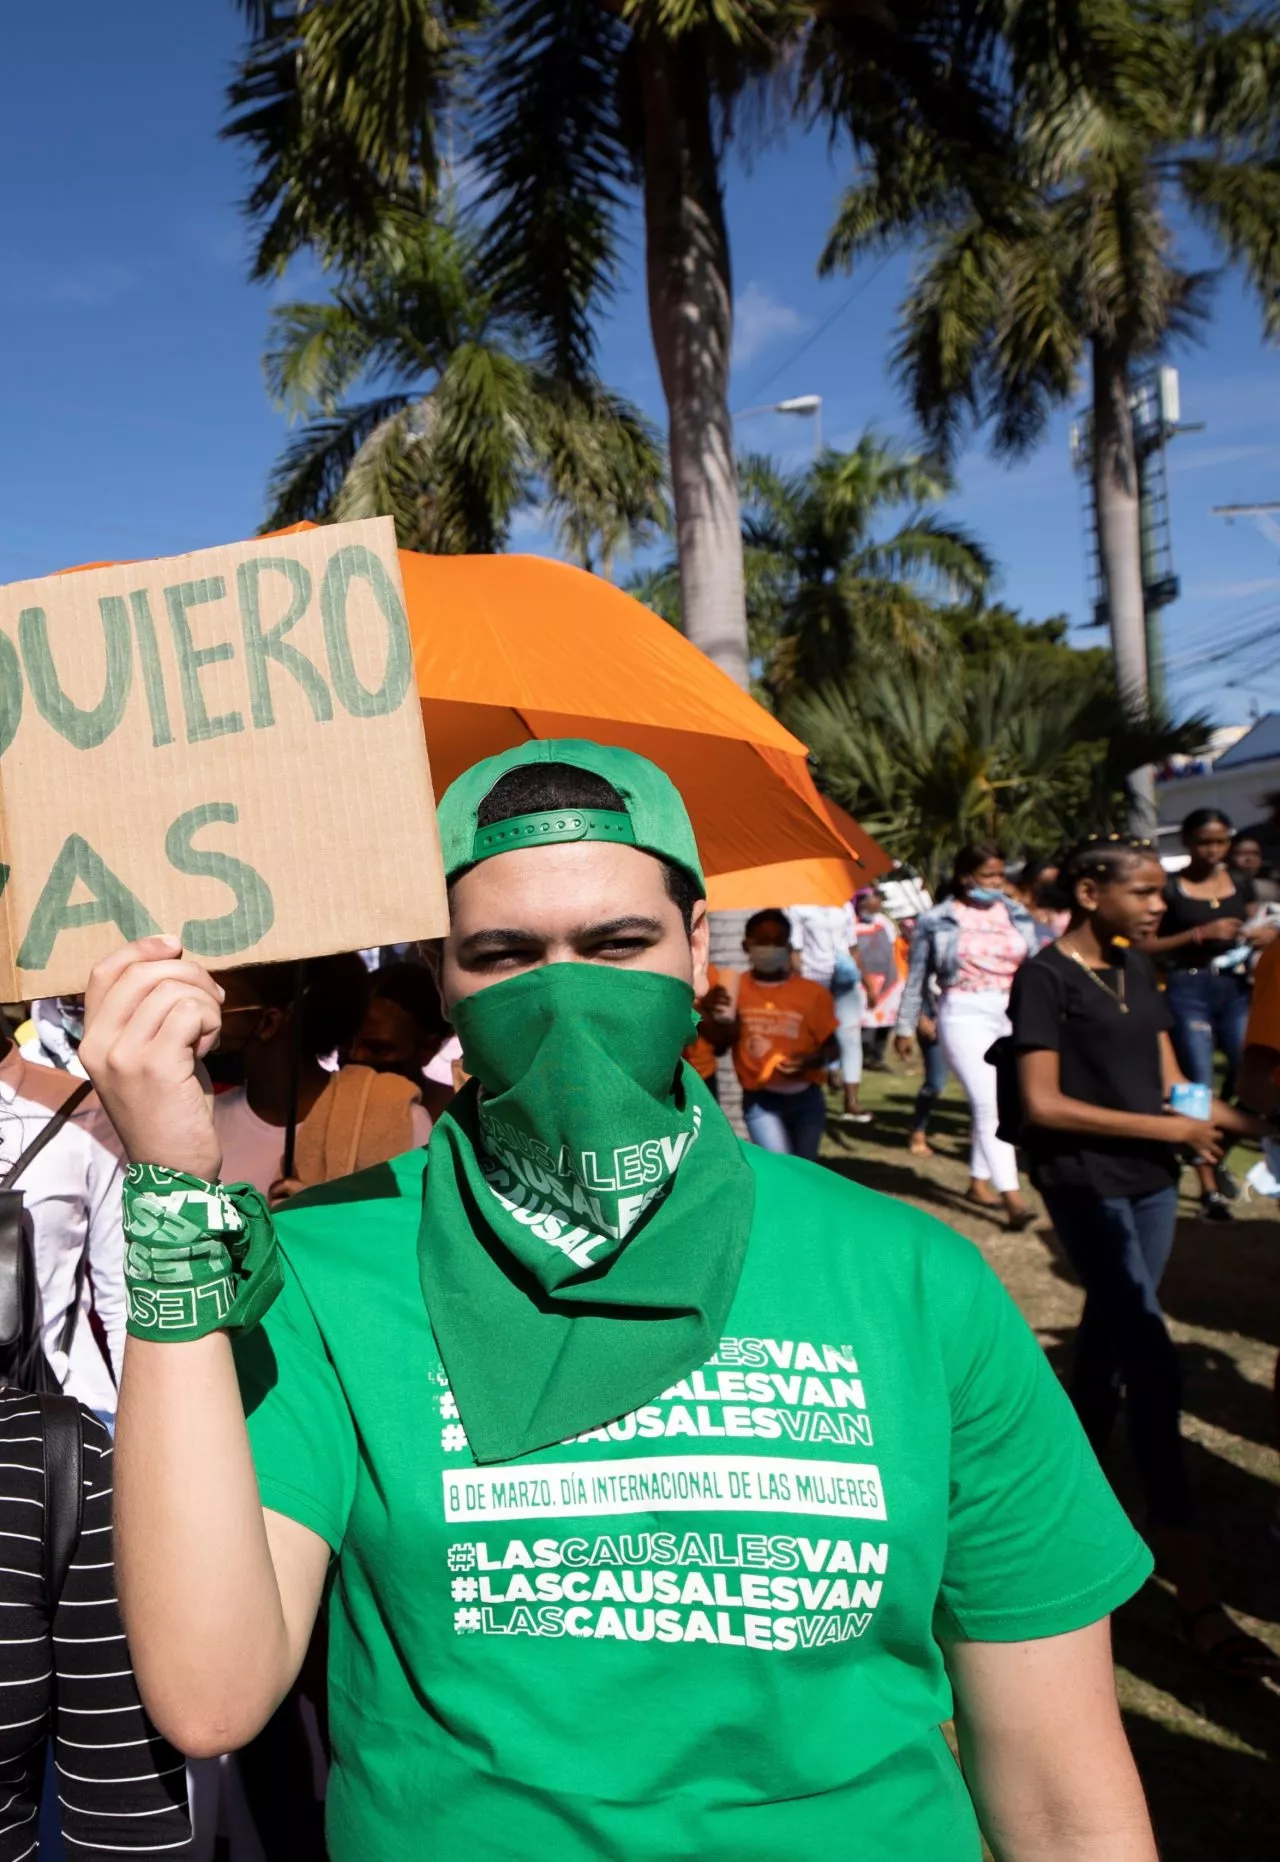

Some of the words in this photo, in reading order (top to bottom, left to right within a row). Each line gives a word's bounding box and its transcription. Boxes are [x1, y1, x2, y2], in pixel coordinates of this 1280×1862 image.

[450, 1484, 461, 1512] 8
[466, 1483, 486, 1511] DE
[491, 1479, 556, 1509] MARZO.
[560, 1472, 587, 1506] DÍA
[592, 1471, 723, 1505] INTERNACIONAL
[728, 1471, 752, 1499] DE
[757, 1472, 791, 1501] LAS
[795, 1474, 878, 1508] MUJERES
[448, 1532, 888, 1574] #LASCAUSALESVAN
[451, 1570, 883, 1612] #LASCAUSALESVAN
[454, 1606, 873, 1651] #LASCAUSALESVAN
